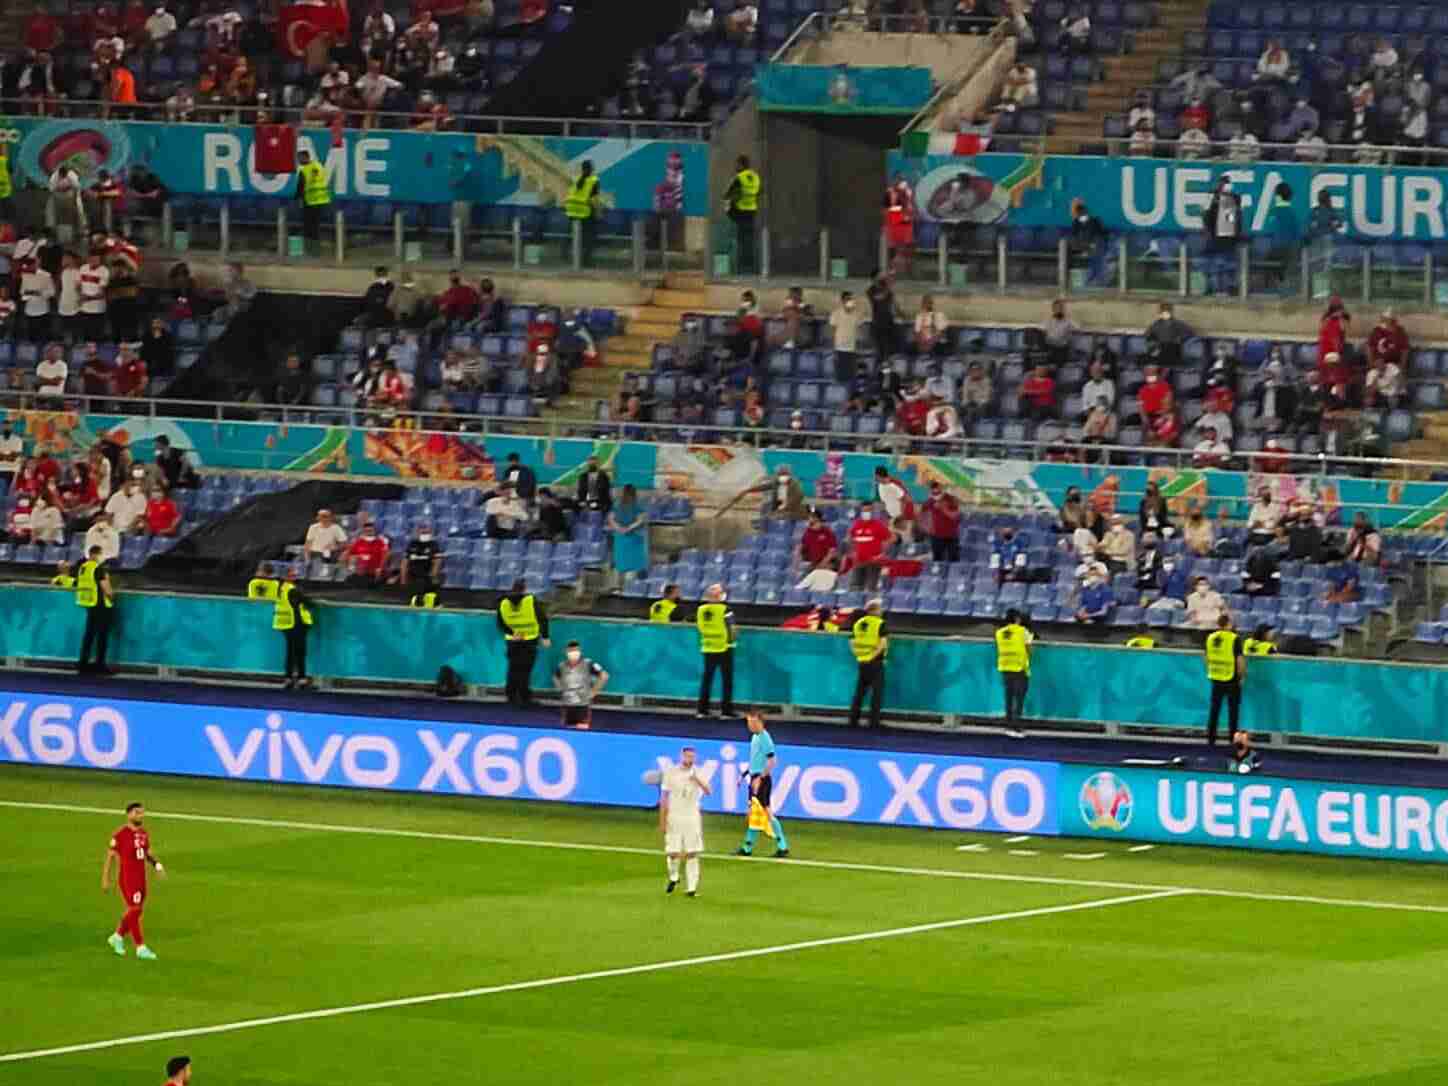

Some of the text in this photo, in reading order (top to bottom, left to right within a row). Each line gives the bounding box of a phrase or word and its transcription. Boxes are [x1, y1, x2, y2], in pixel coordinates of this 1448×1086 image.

[205, 713, 577, 800] vivo X60
[879, 760, 1045, 832] X60
[1157, 779, 1309, 843] UEFA
